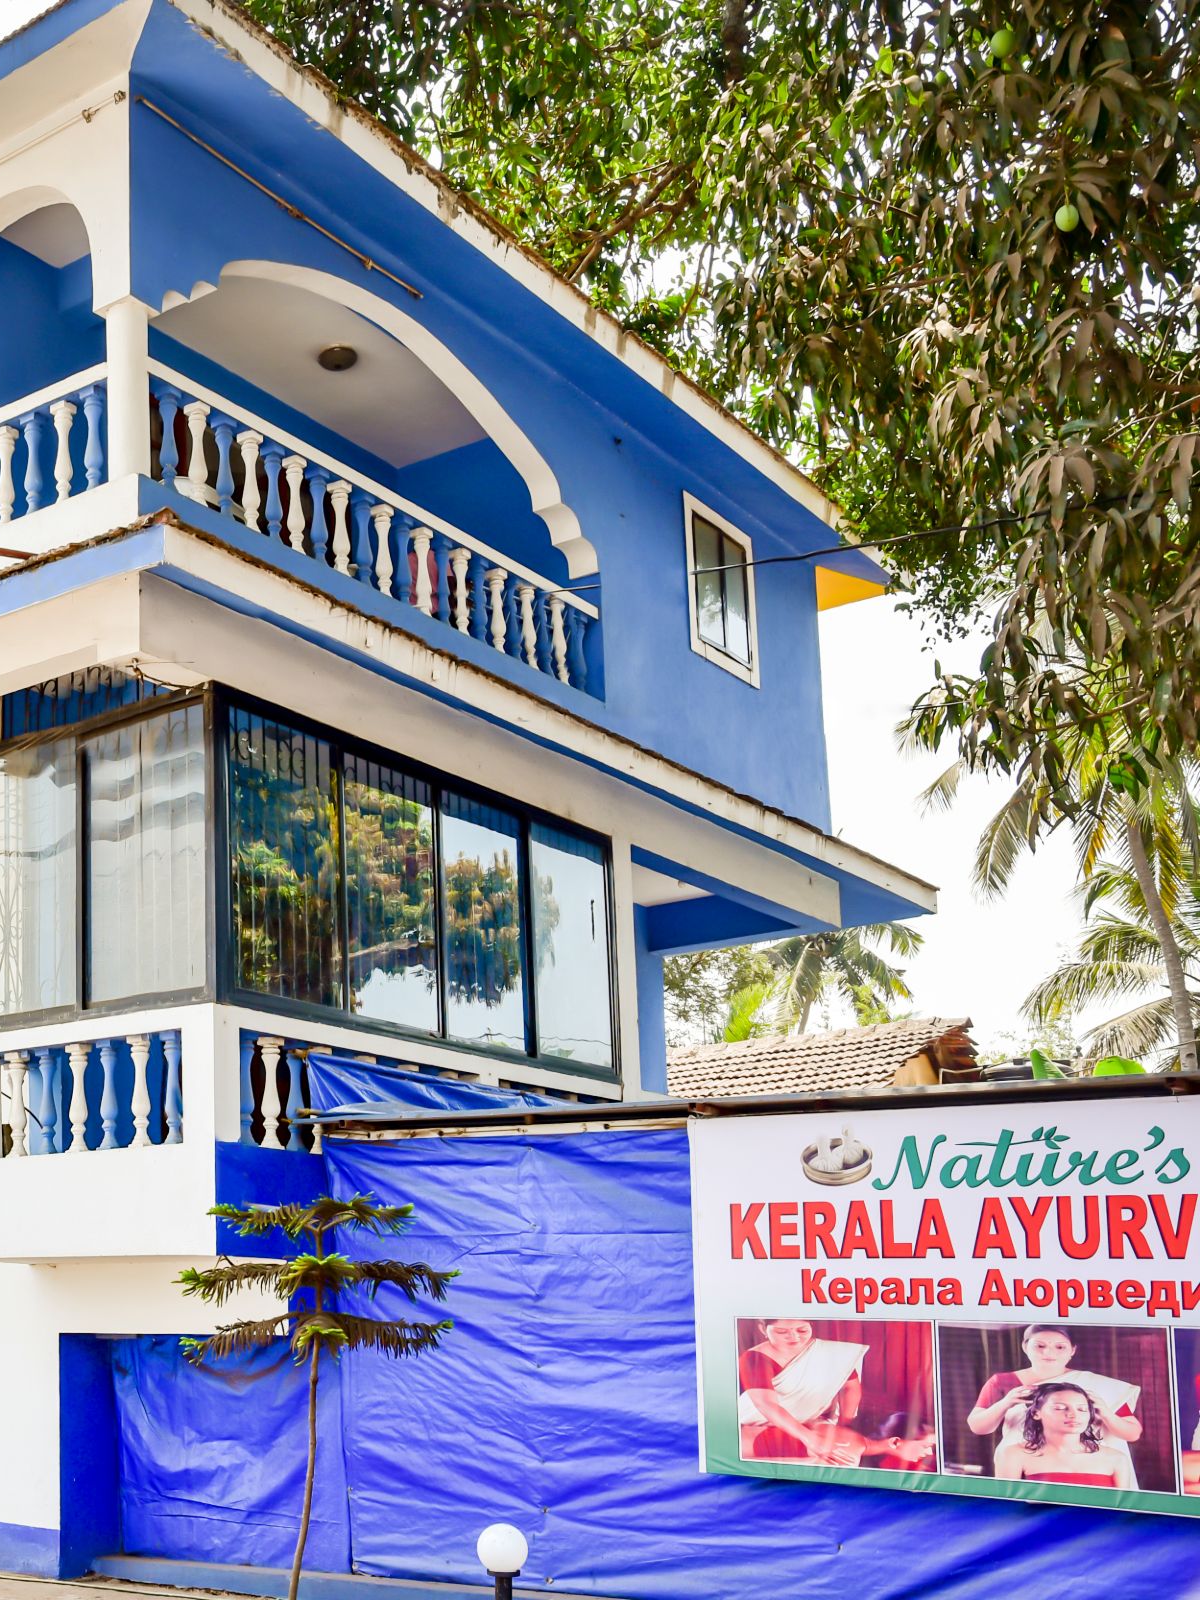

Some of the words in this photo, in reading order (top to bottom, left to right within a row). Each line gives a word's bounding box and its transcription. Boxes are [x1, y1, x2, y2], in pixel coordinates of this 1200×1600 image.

[872, 1125, 1191, 1190] Nature's
[729, 1198, 955, 1260] KERALA
[972, 1193, 1199, 1260] AYURV
[801, 1268, 963, 1313] Керала
